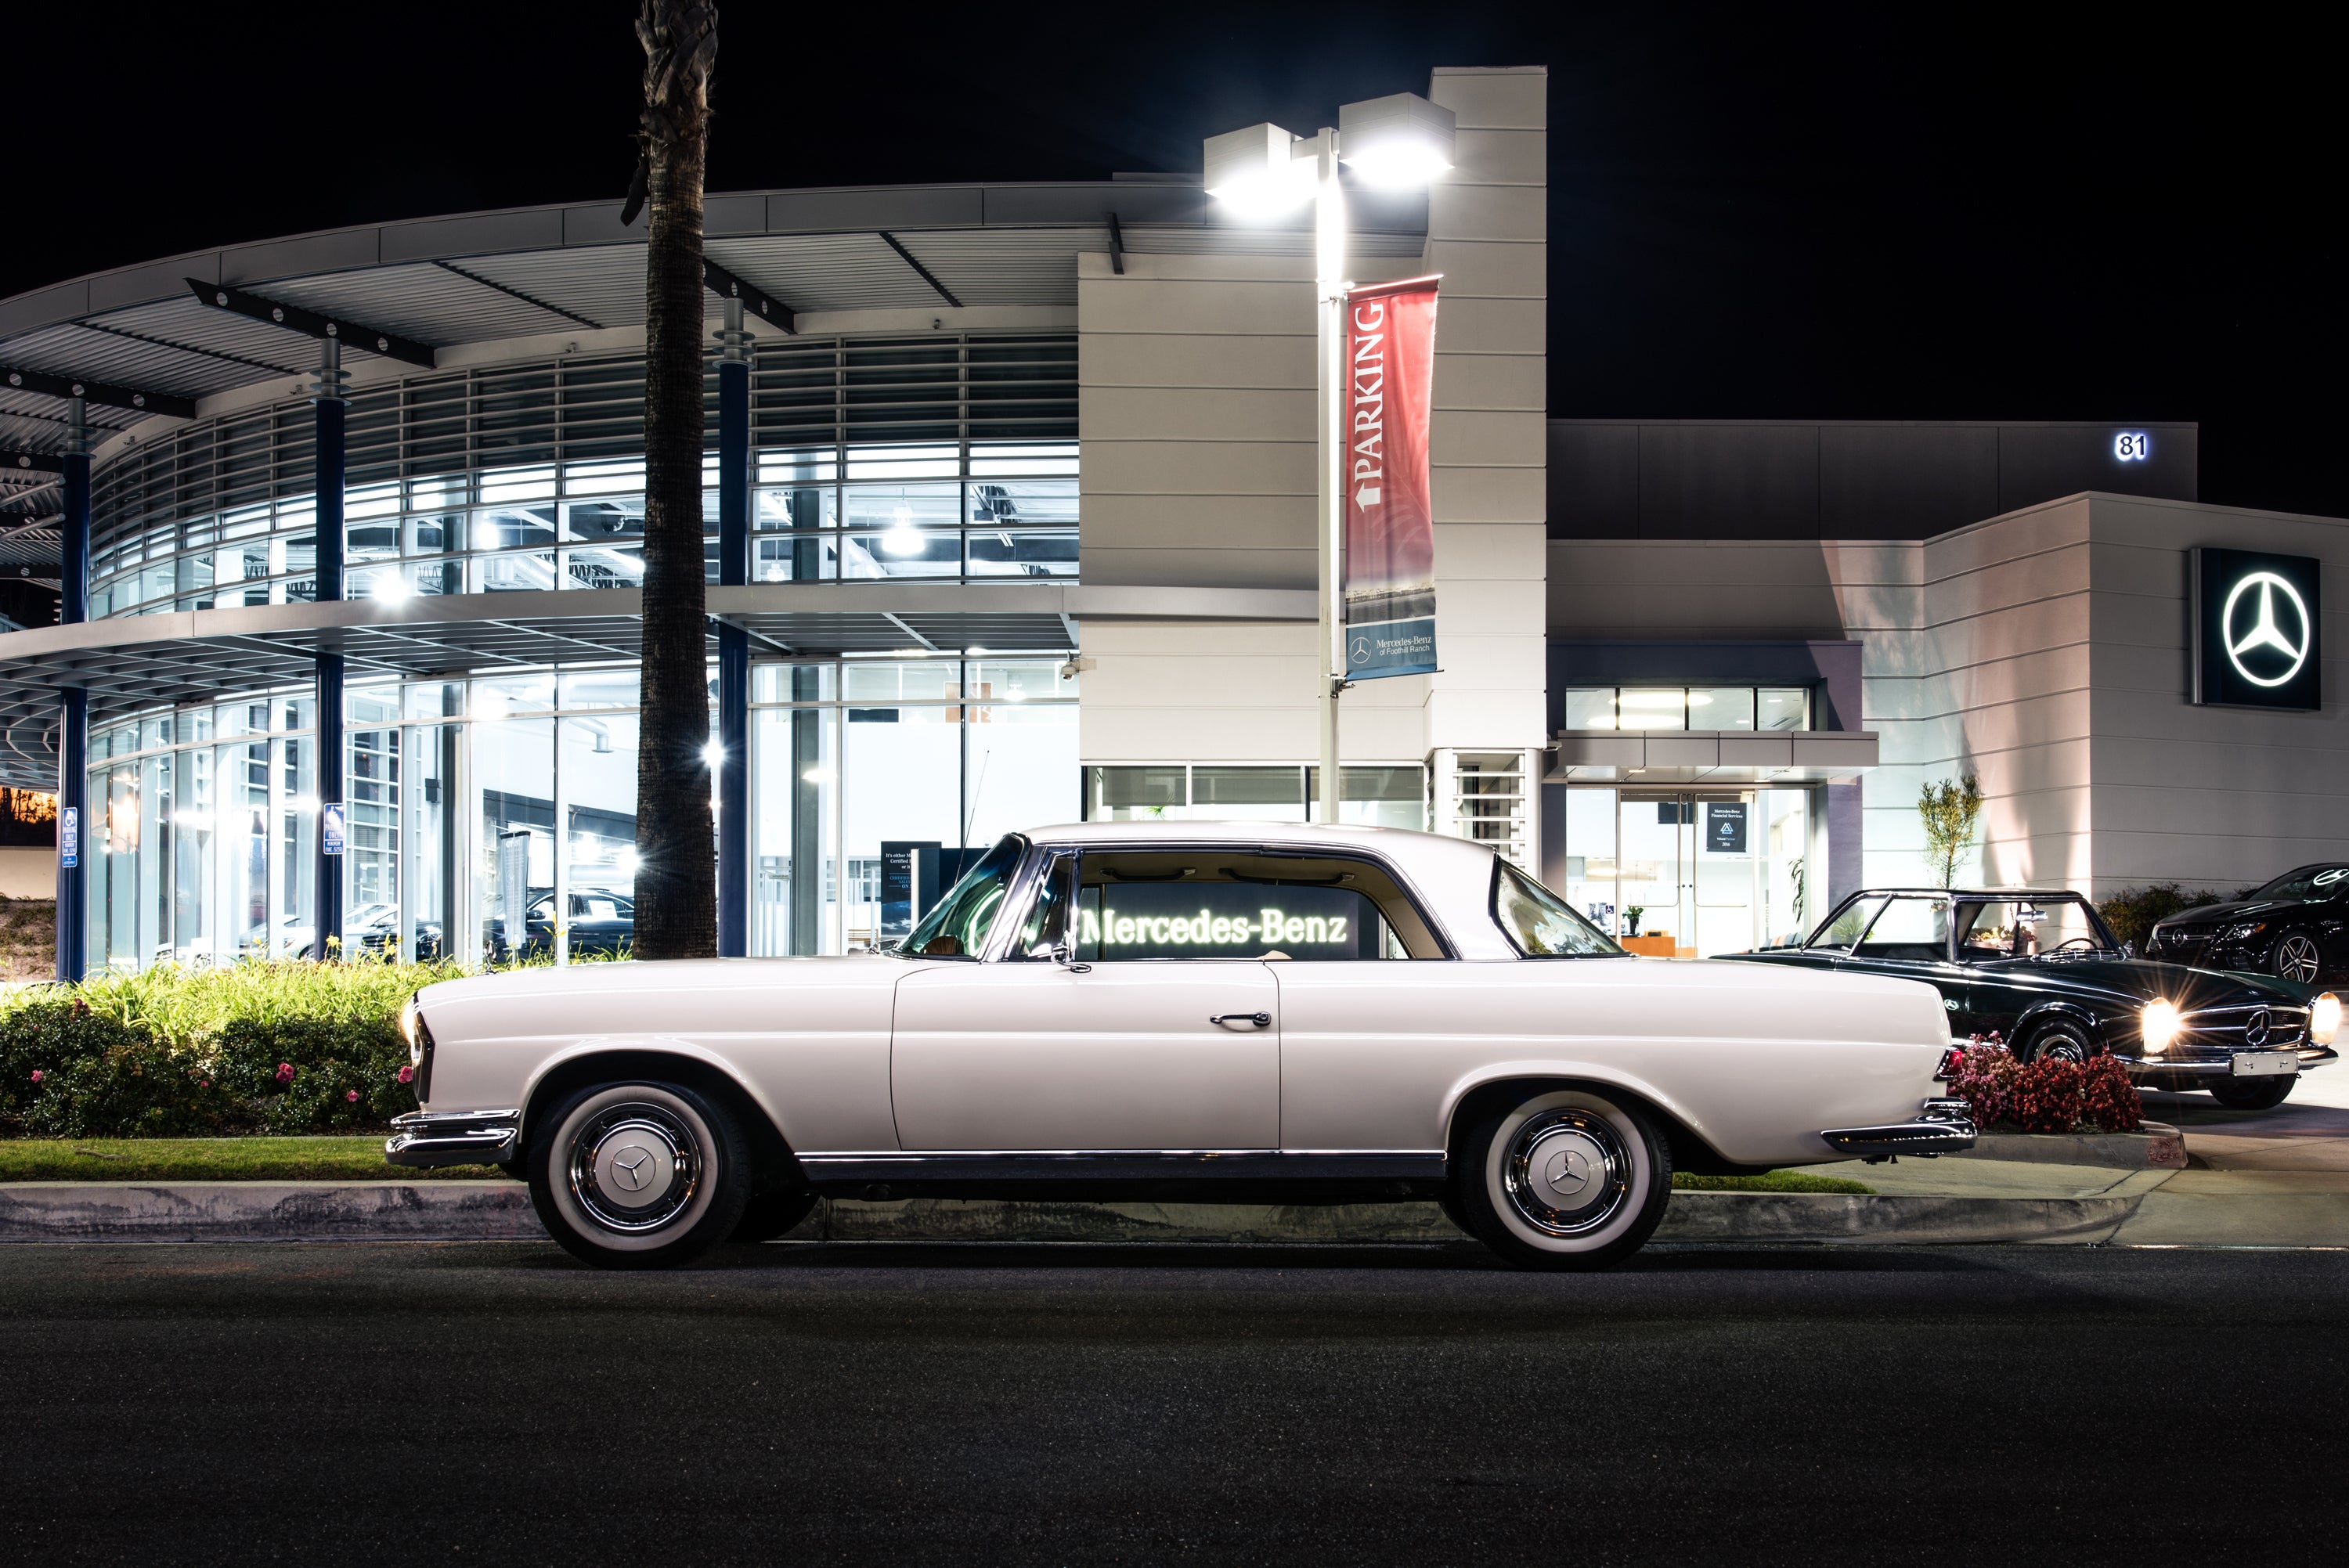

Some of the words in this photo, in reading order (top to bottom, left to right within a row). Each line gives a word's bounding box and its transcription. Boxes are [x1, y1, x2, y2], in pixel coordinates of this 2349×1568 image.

[1355, 303, 1384, 483] PARKING
[2120, 435, 2145, 456] 81
[1377, 636, 1432, 649] Mercedes-Benz
[1386, 647, 1409, 655] Foothill
[1409, 644, 1430, 653] Ranch
[1080, 908, 1347, 944] Mercedes-Benz
